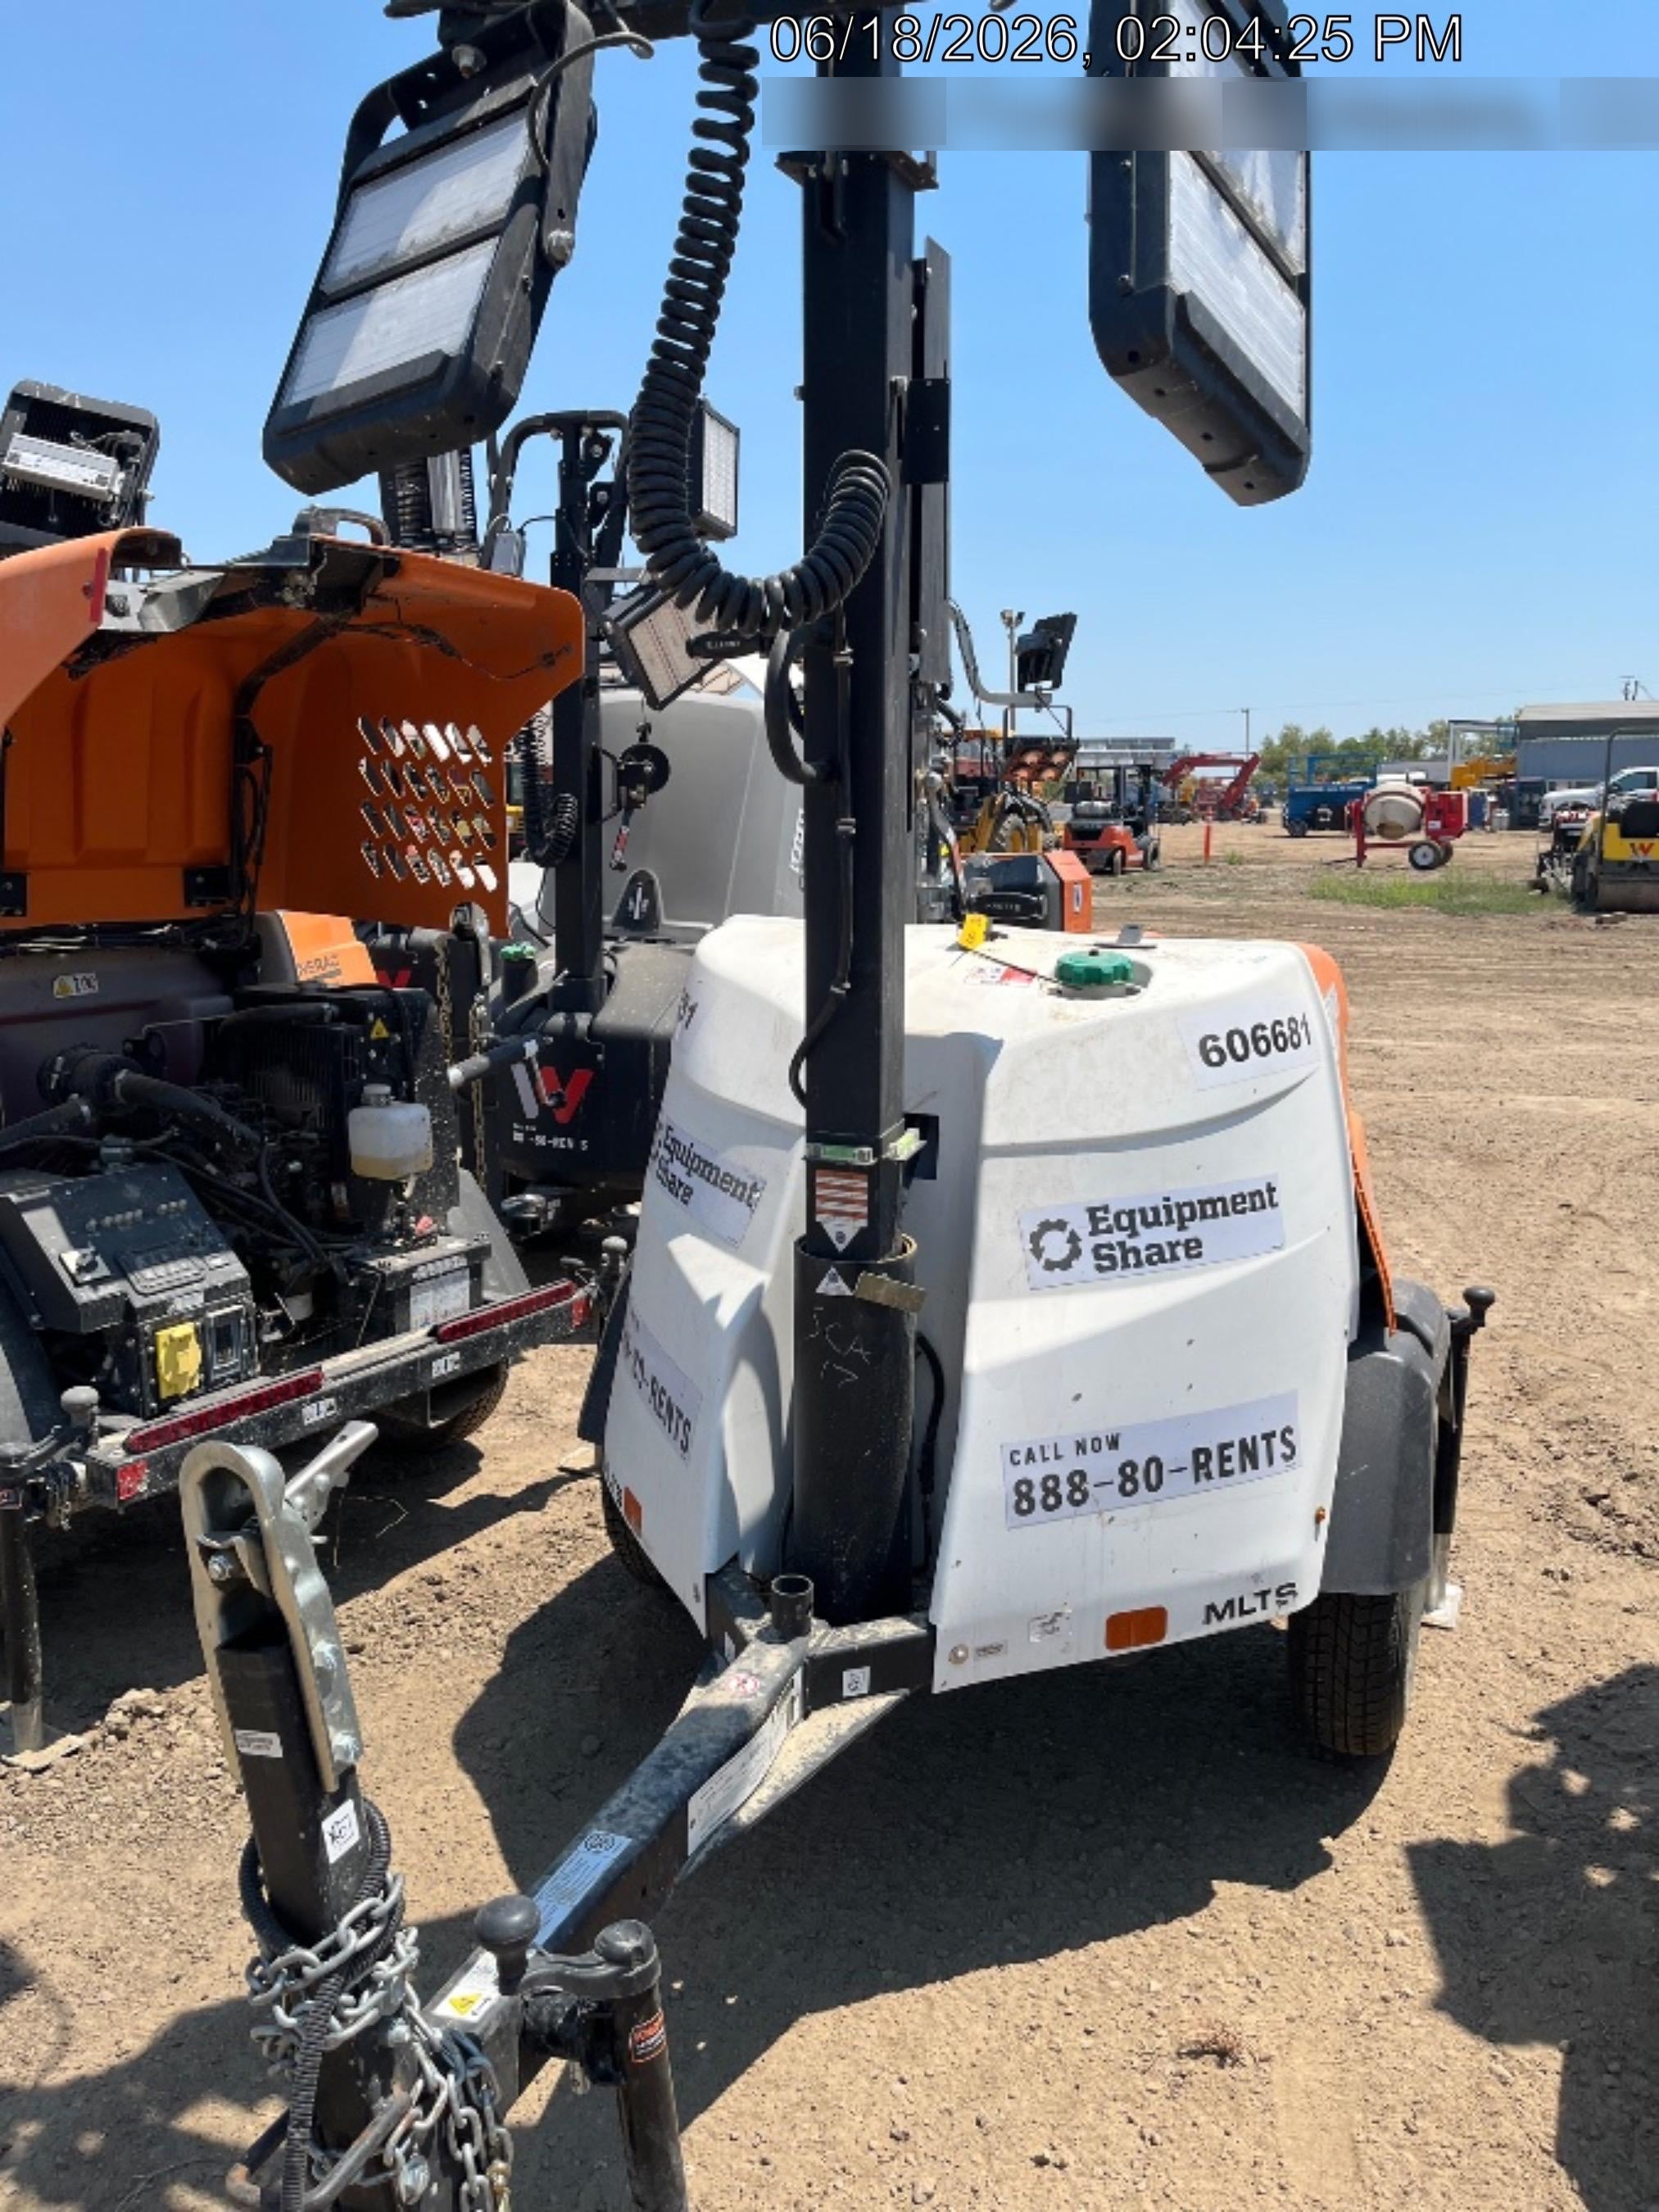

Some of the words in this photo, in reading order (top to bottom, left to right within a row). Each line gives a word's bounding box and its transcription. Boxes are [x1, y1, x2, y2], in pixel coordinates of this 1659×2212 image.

[1199, 1013, 1311, 1067] 606681
[664, 1125, 763, 1212] Equipment
[1086, 1182, 1279, 1238] Equipment
[1090, 1235, 1203, 1273] Share
[1009, 1443, 1063, 1466] CALL
[1075, 1433, 1121, 1457] NOW
[1013, 1426, 1297, 1516] 888-80-RENTS
[1202, 1582, 1299, 1625] MLTS
